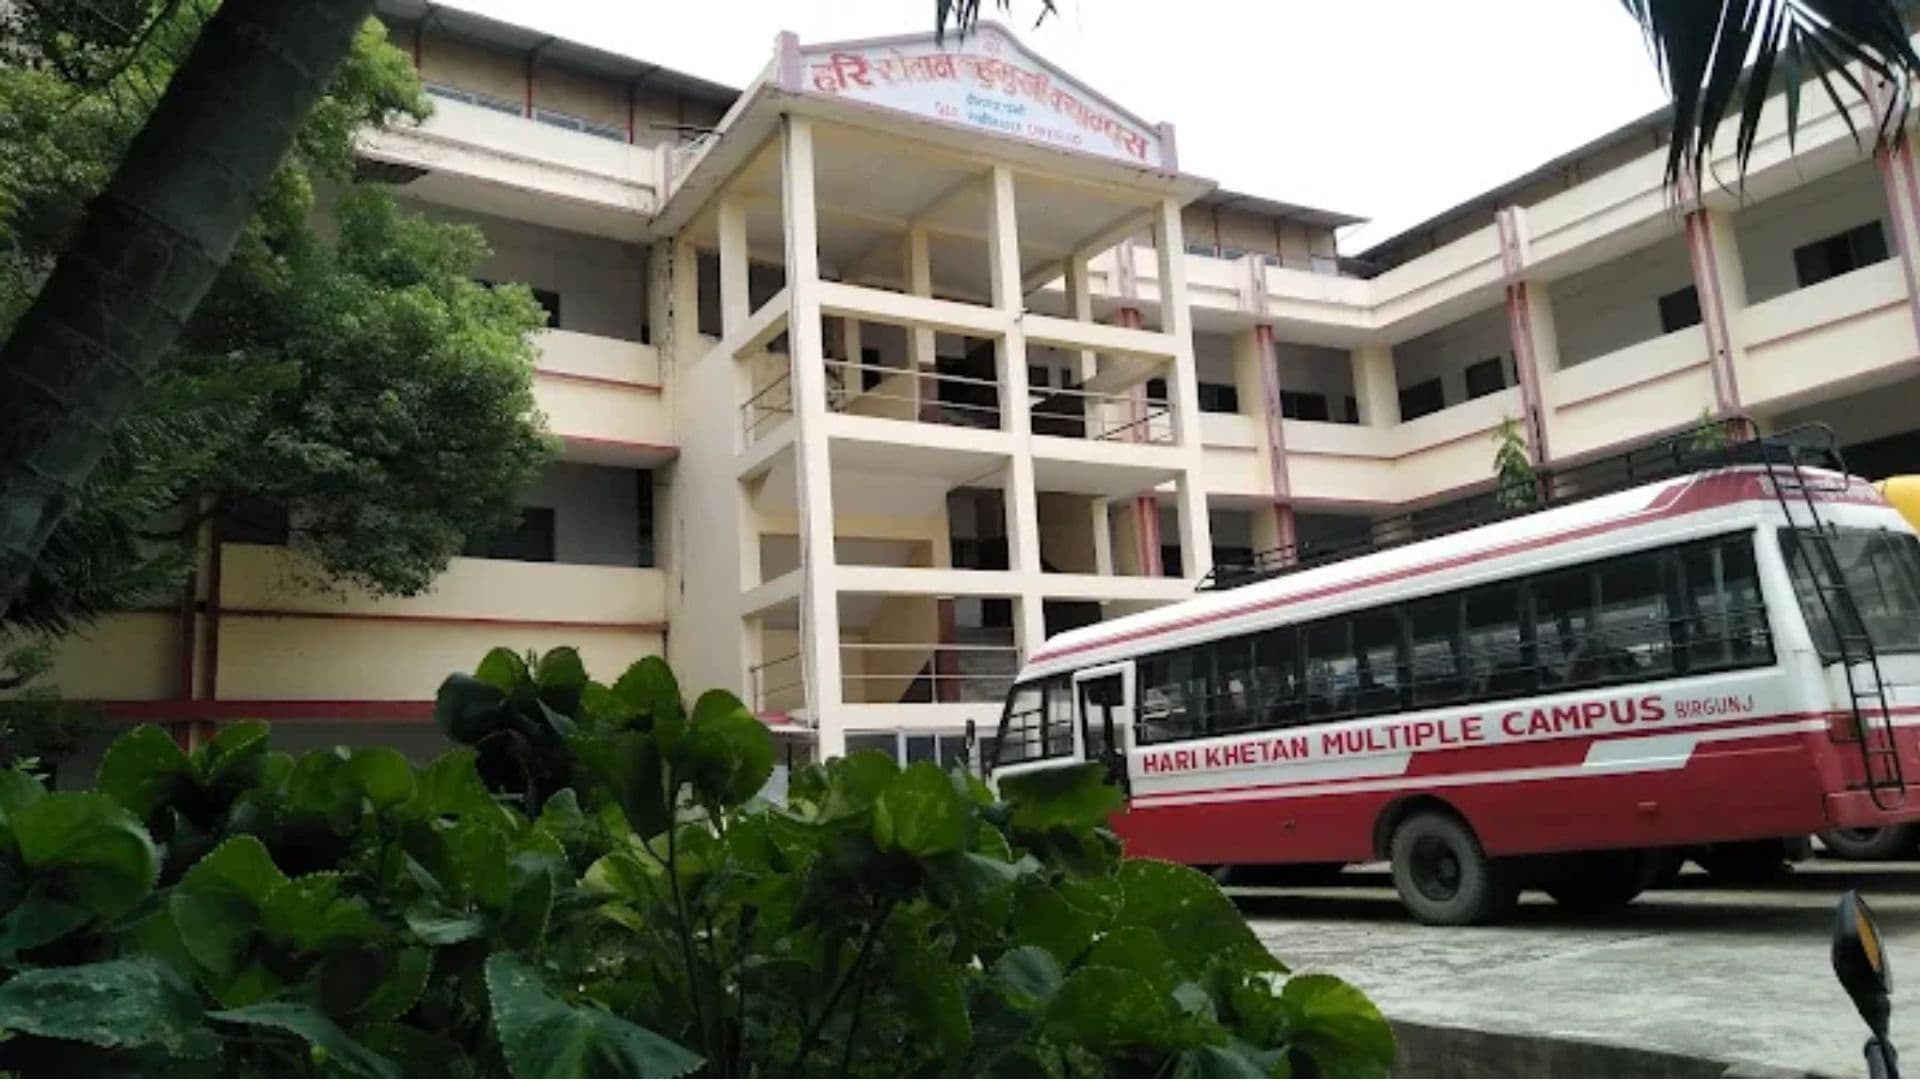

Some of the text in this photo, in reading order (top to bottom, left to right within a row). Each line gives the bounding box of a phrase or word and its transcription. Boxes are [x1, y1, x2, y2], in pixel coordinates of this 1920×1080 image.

[812, 52, 873, 92] हरि
[1143, 694, 1755, 773] HARI KHETAN MULTIPLE CAMPUS BIRGUNJ
